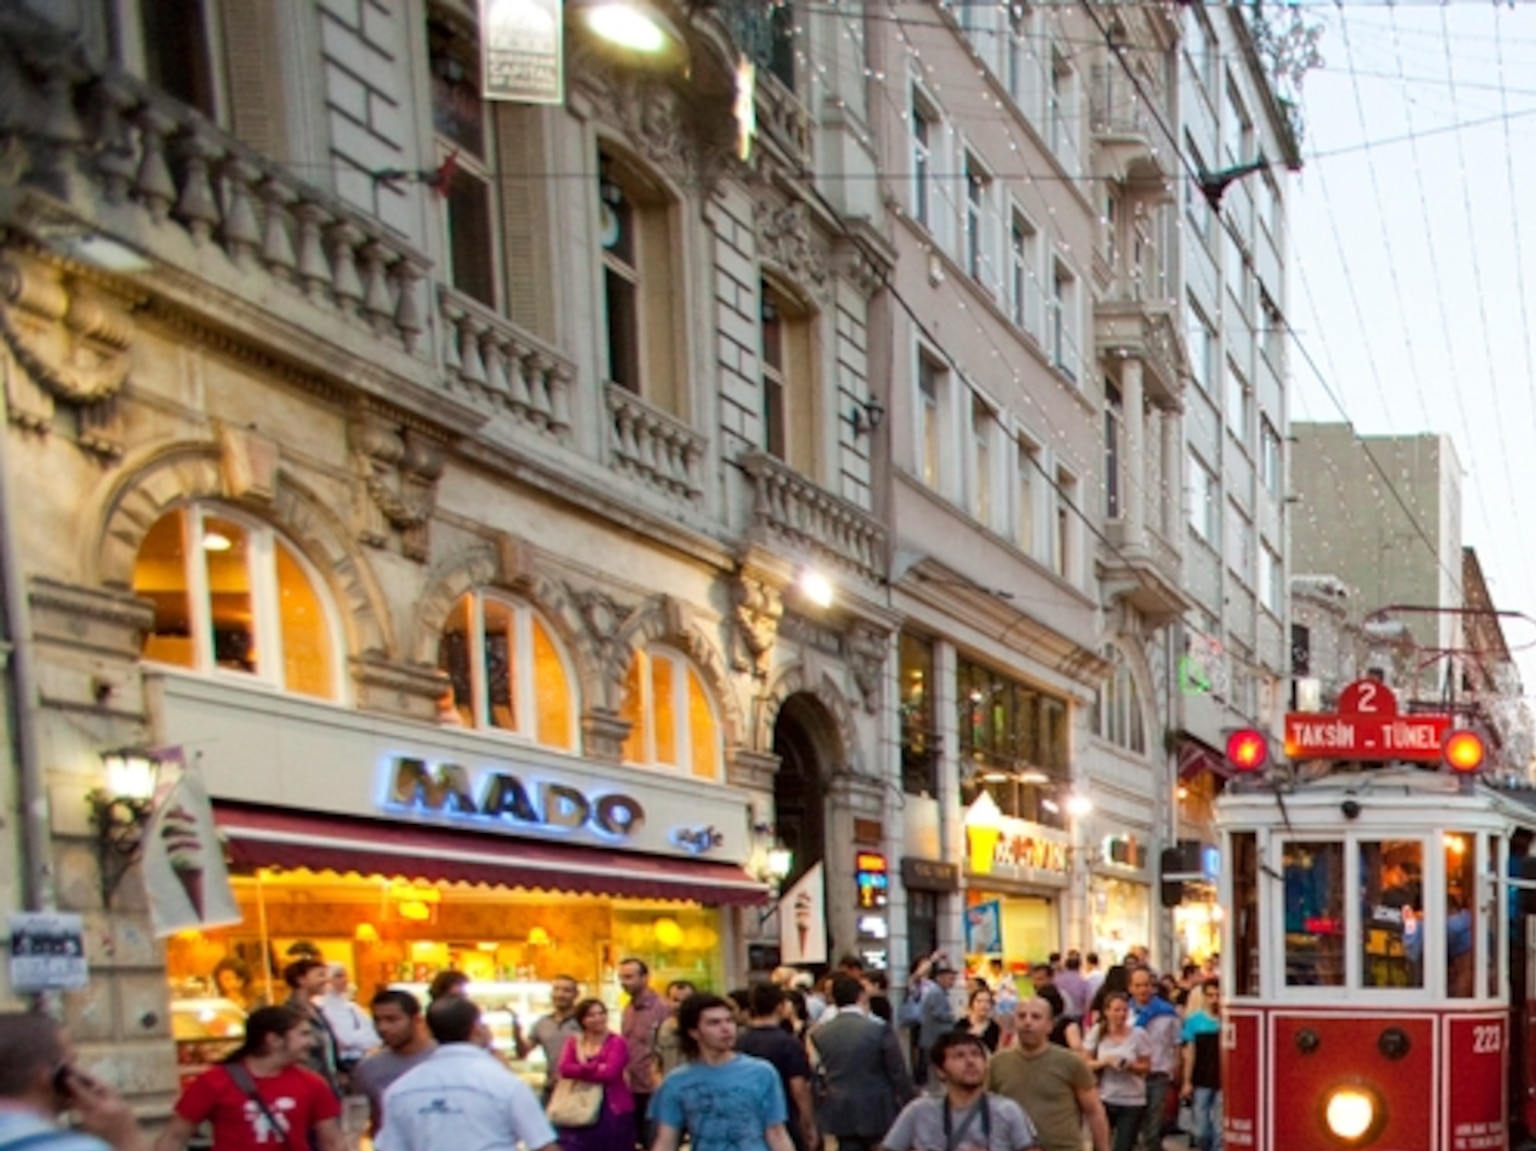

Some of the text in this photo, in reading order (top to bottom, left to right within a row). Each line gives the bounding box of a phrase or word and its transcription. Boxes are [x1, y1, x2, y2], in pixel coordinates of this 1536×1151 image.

[489, 63, 556, 81] CAPITAL
[1357, 682, 1378, 713] 2
[1293, 719, 1355, 748] TAKSİM
[1381, 721, 1441, 749] TÜNEL
[388, 756, 646, 836] MADO
